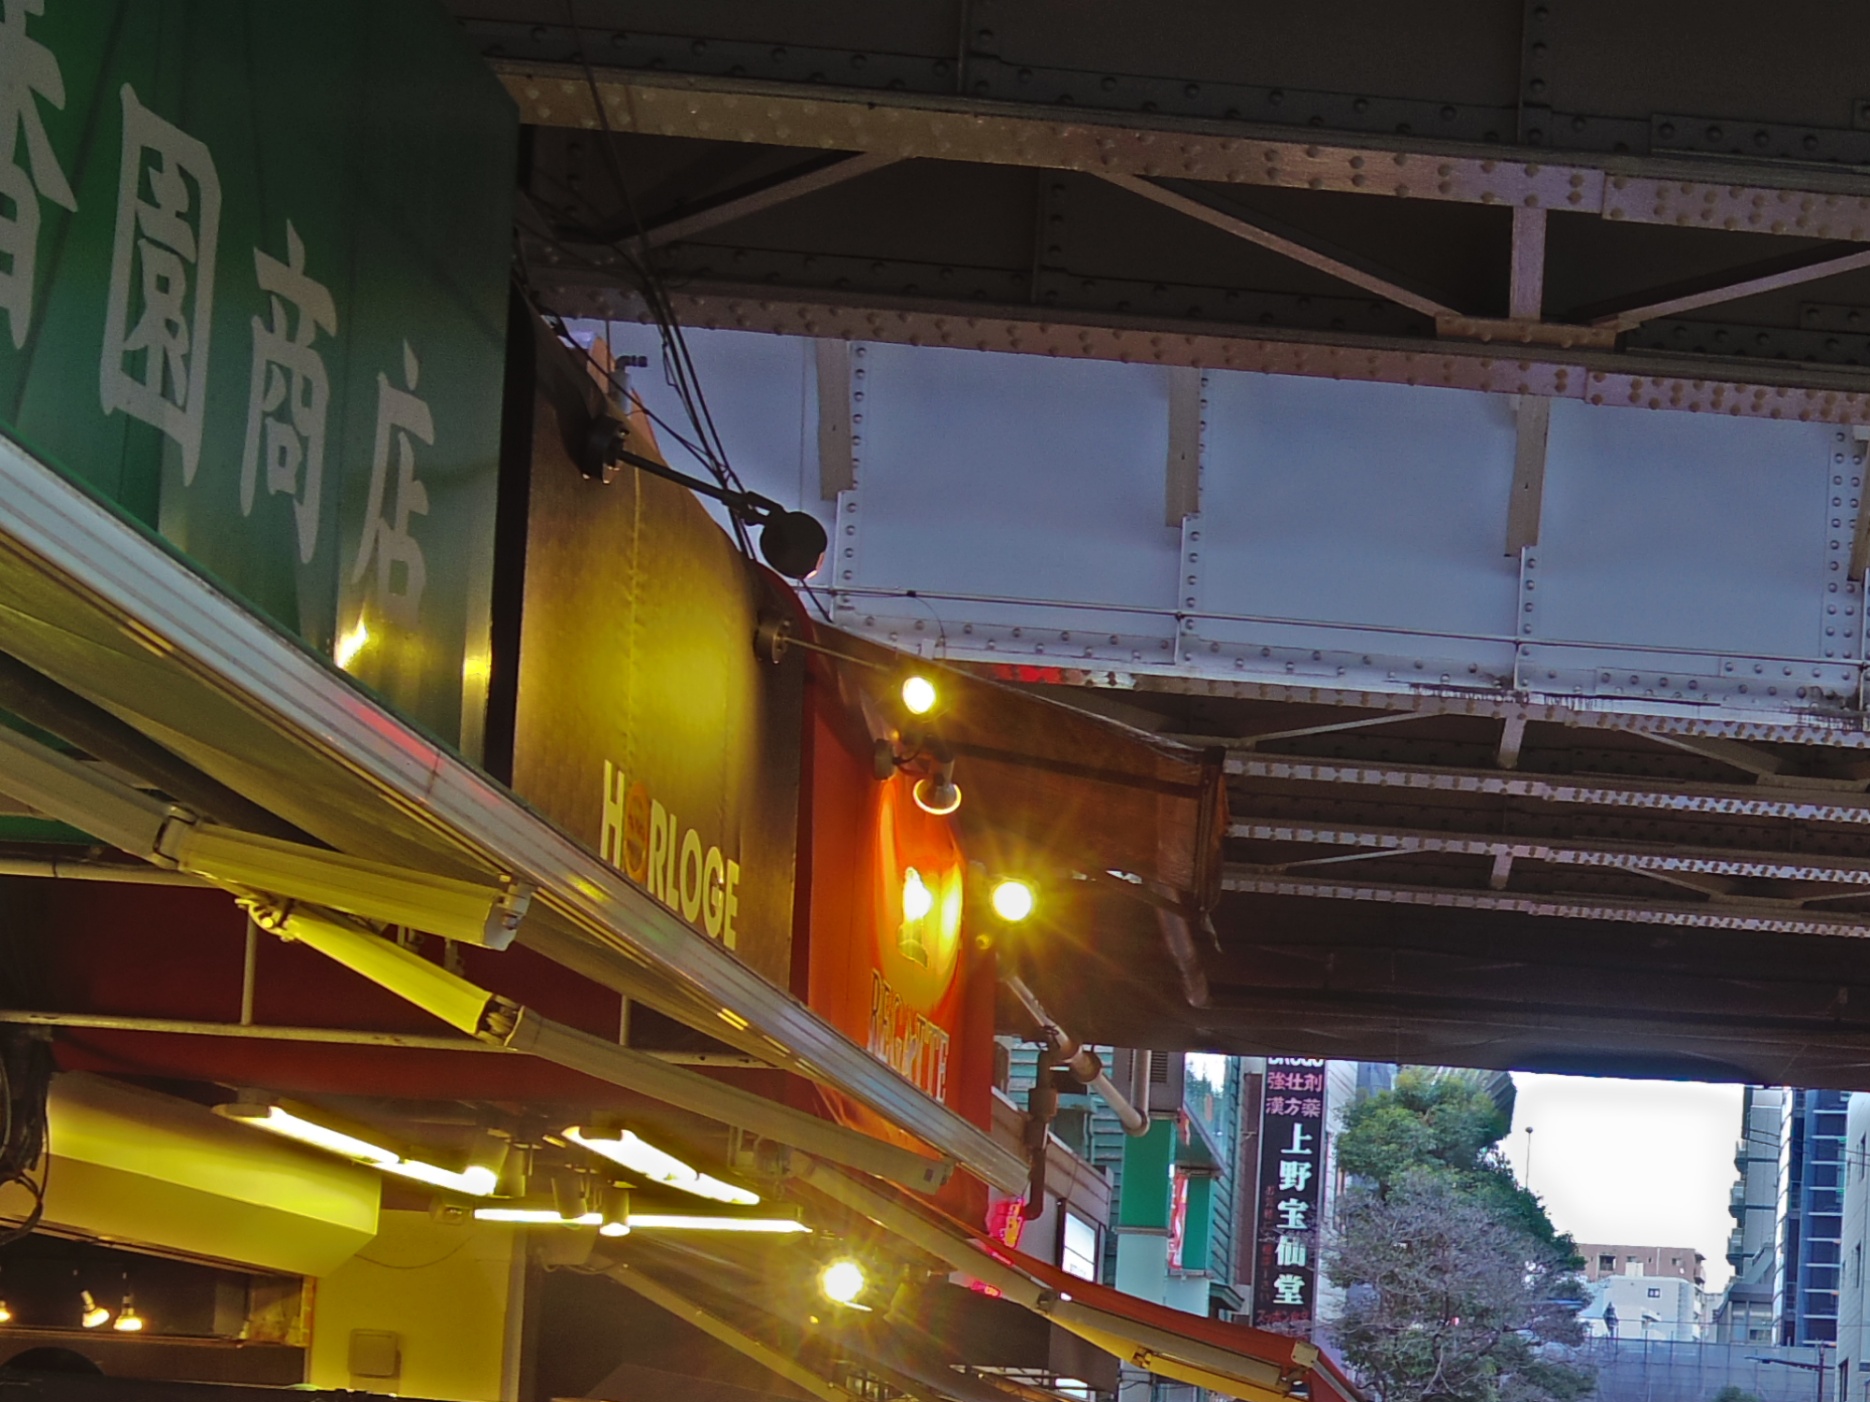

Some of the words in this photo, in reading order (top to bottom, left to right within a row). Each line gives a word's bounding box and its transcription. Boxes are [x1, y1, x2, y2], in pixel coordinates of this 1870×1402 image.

[1265, 1096, 1321, 1118] 漢方薬
[1273, 1123, 1313, 1305] 上野宝仙堂
